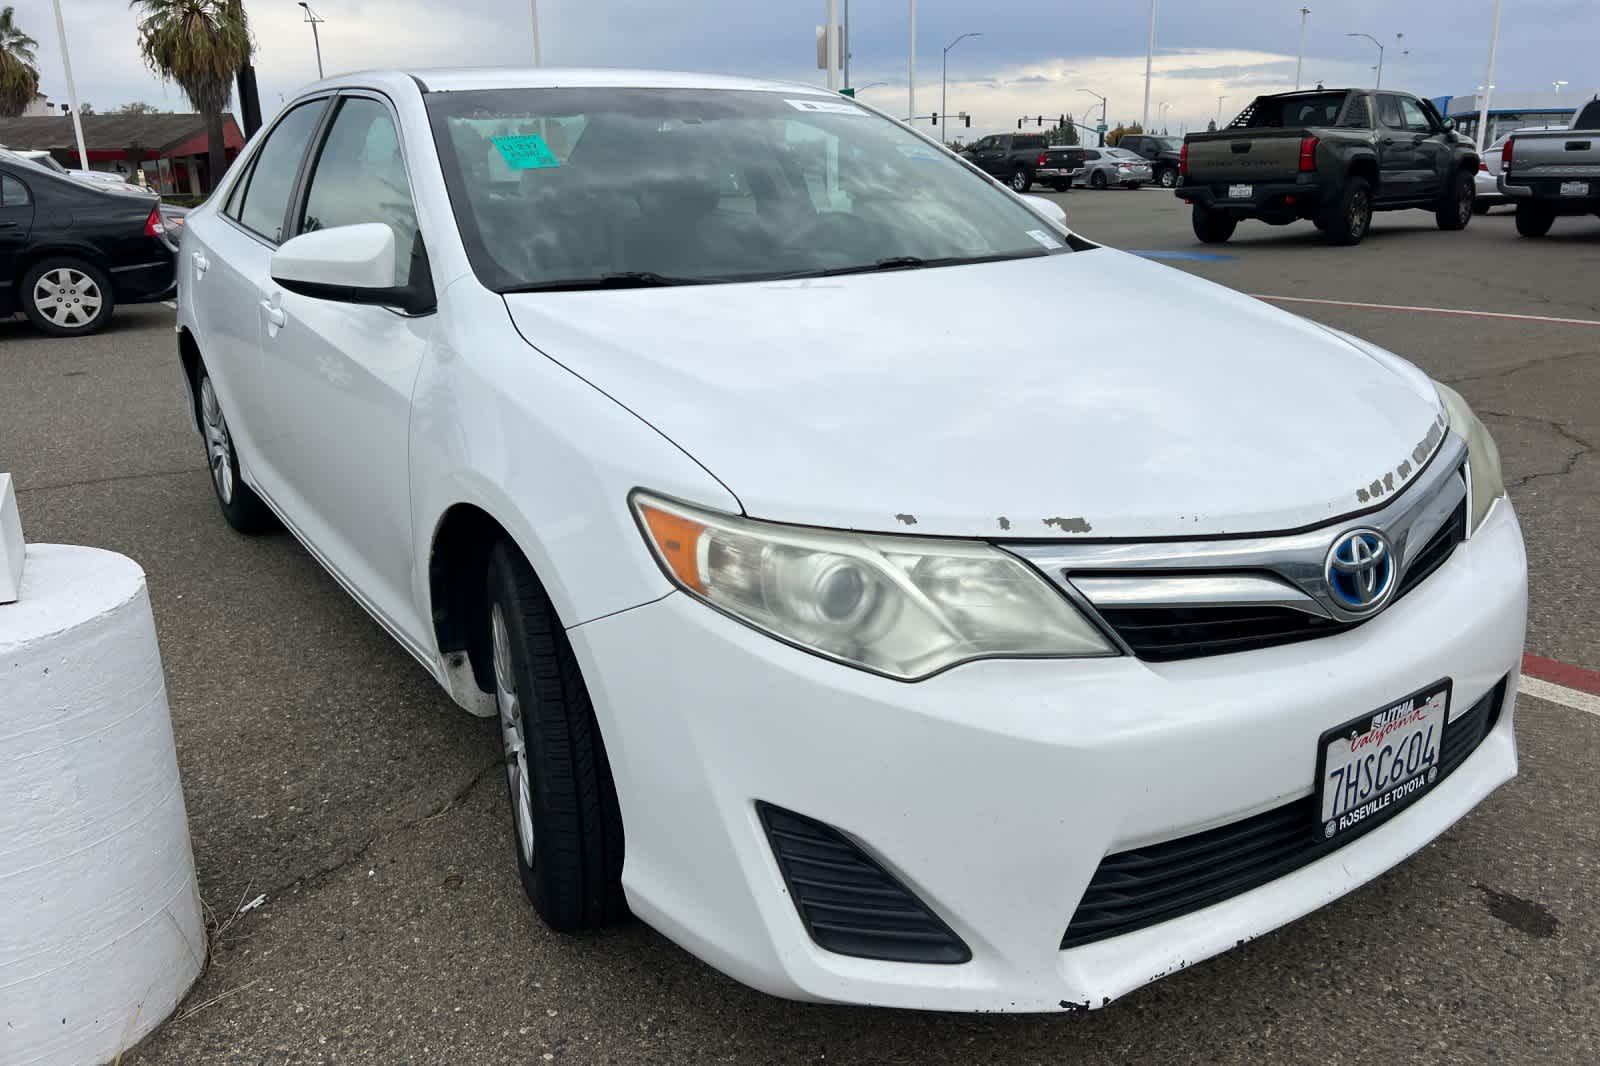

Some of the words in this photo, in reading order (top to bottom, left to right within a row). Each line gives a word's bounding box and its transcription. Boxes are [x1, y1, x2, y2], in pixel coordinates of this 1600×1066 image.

[1351, 710, 1427, 752] California
[1380, 699, 1414, 727] LITHIA
[1330, 724, 1435, 817] 7HSC604
[1340, 792, 1391, 830] ROSEVILLE
[1392, 774, 1425, 802] TOYOTA
